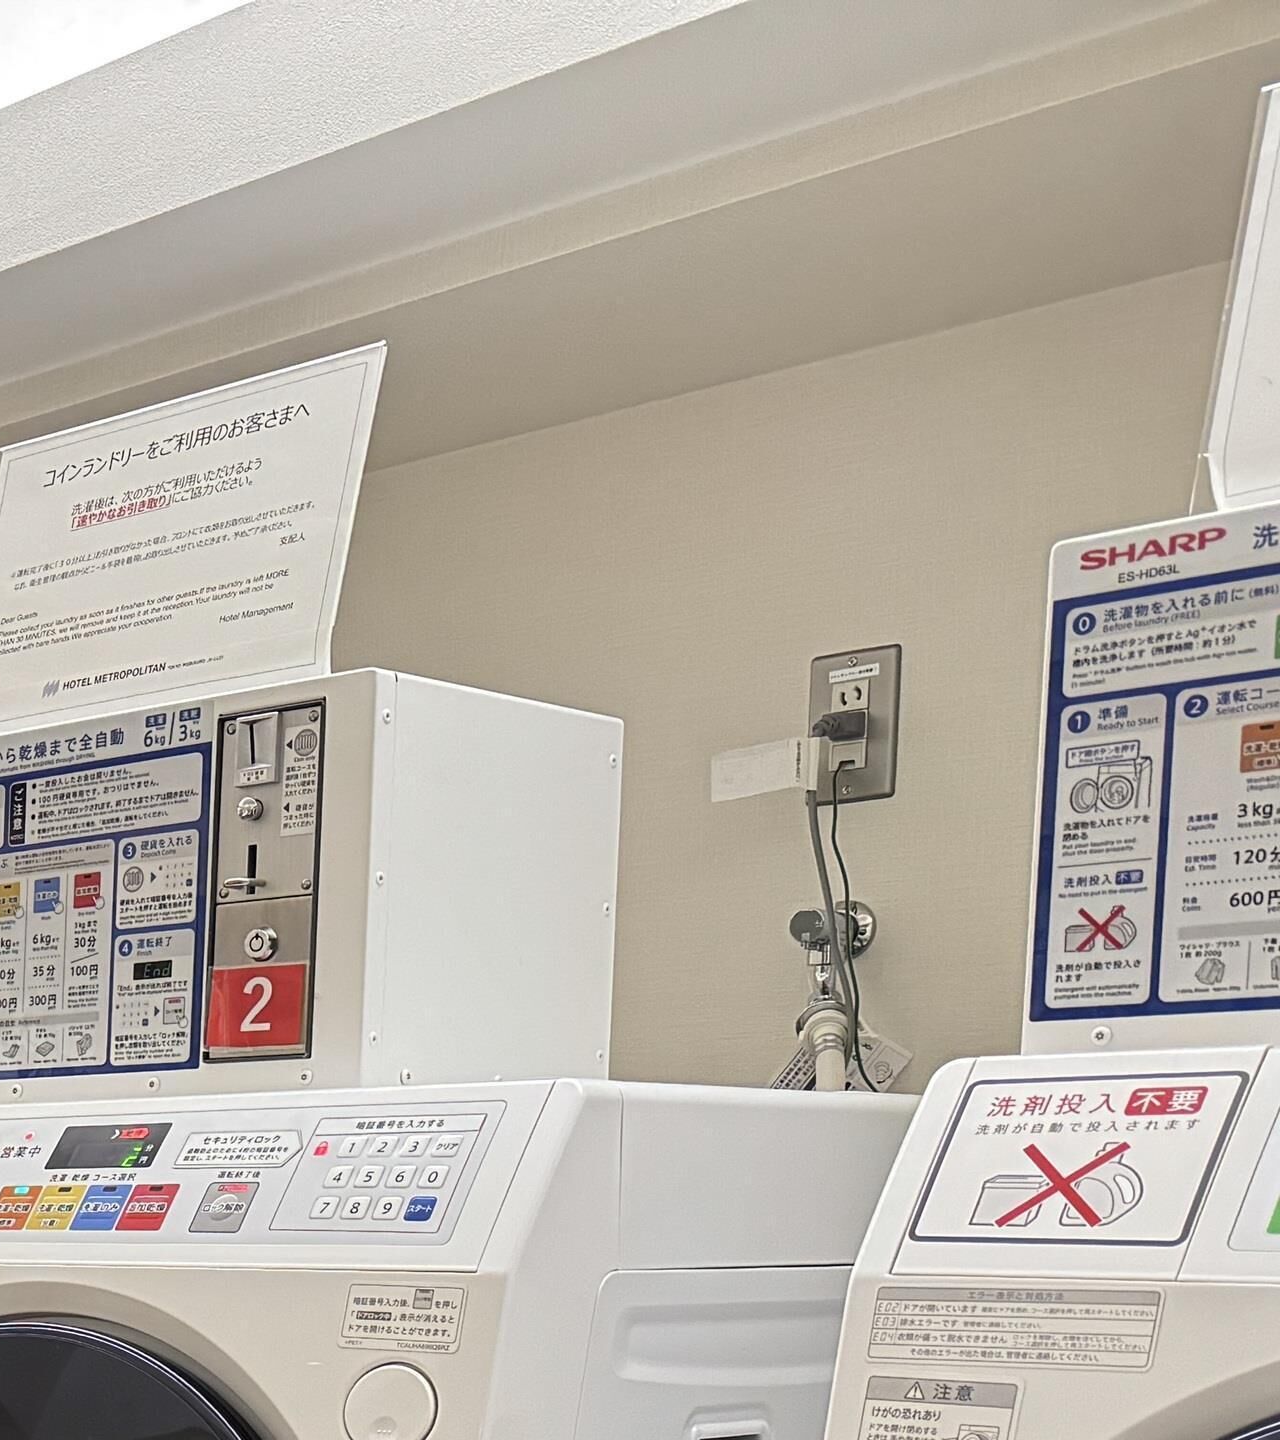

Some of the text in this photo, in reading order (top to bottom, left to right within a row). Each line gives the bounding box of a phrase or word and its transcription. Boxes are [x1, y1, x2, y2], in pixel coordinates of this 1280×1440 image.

[43, 404, 310, 487] コインランドリーをご利用のお客さまへ
[71, 458, 262, 515] 洗濯後は、次の方がご利用いただけるよう
[279, 533, 305, 546] 支配人
[1080, 527, 1227, 570] SHARP
[1118, 565, 1180, 584] ES-HD63L
[219, 602, 294, 623] Hotel Management
[1104, 588, 1245, 623] 洗濯物を入れる前に
[1103, 610, 1201, 633] Before laundry (FREE)
[62, 662, 167, 691] HOTEL METROPOLITAN
[1098, 705, 1129, 720] 準備
[1216, 700, 1280, 715] Select Course
[1098, 715, 1159, 731] Ready to Start
[1186, 823, 1215, 832] Capacity
[140, 836, 193, 850] 硬貨を入れる
[141, 850, 160, 858] Deposit
[1064, 874, 1112, 888] 洗剤投入
[137, 936, 172, 949] 運転終了
[71, 964, 99, 977] 100円
[143, 962, 172, 978] End
[1055, 973, 1083, 984] れます
[29, 994, 57, 1006] 300円
[239, 976, 274, 1033] 2
[986, 1088, 1204, 1118] 洗剤投入 不要
[203, 1119, 446, 1145] セキュリティロック 暗証番号を入力する
[974, 1118, 1201, 1136] 洗剤が自動で投入されます
[0, 1146, 42, 1159] 営業中
[377, 1141, 459, 1152] 2 3 クリア
[92, 1173, 137, 1182] コース選択
[218, 1170, 261, 1179] 運転終了後
[332, 1172, 438, 1182] 4 5 6 0
[320, 1202, 432, 1214] 7 8 9 スタート
[435, 1300, 458, 1310] を押し
[903, 1301, 977, 1313] ドアが開いています
[899, 1317, 959, 1328] 排水エラーです
[348, 1324, 452, 1338] ドアを開けることができます。
[933, 1383, 975, 1402] 注意
[872, 1407, 941, 1421] けがの恐れあり
[868, 1423, 938, 1436] ドアを開け閉めする
